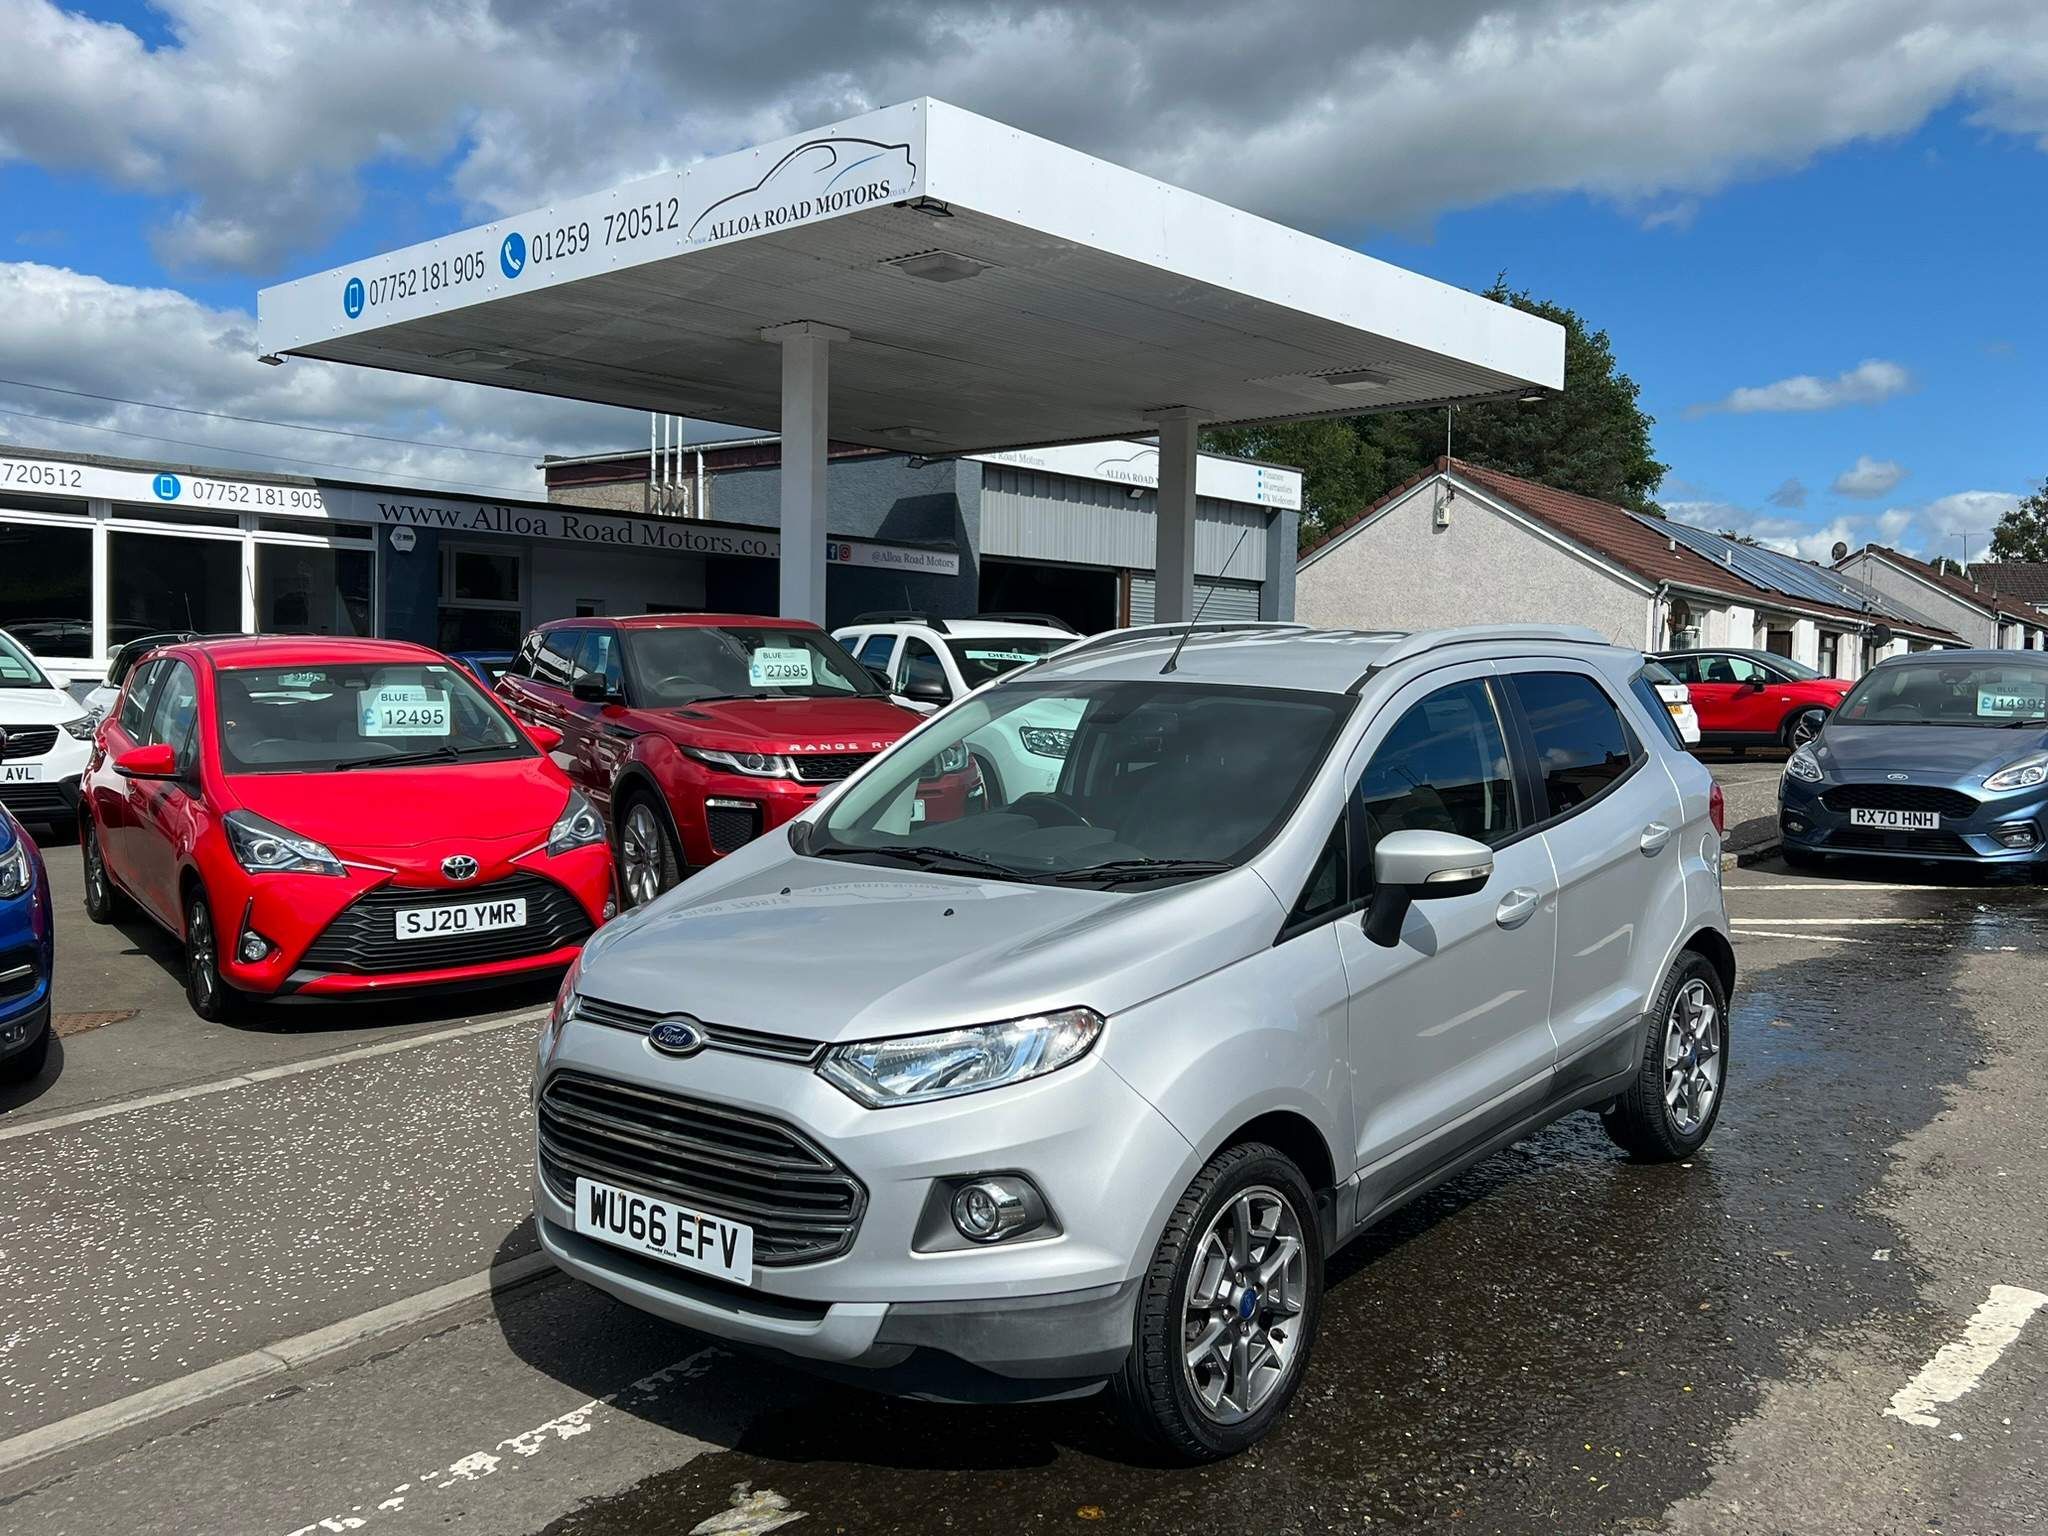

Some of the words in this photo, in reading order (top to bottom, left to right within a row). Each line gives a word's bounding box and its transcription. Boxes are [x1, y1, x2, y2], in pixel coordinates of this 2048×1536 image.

[708, 214, 761, 242] ALLOA
[764, 201, 812, 228] ROAD
[815, 179, 890, 215] MOTORS
[532, 222, 590, 263] 01259
[604, 197, 679, 245] 720512
[370, 269, 416, 305] 07752
[422, 261, 448, 292] 181
[454, 251, 485, 285] 905
[3, 463, 82, 487] 720512
[193, 481, 249, 503] 07752
[255, 488, 285, 506] 181
[290, 490, 323, 509] 905
[561, 516, 634, 544] Road
[641, 524, 781, 557] Motors.co.
[903, 553, 924, 566] Road
[926, 555, 954, 568] Motors
[988, 652, 1025, 660] DIESEL
[766, 664, 808, 677] 27995
[381, 693, 409, 702] BLUE
[385, 709, 444, 725] 12495
[788, 743, 859, 751] RANGE
[5, 767, 35, 781] AVL
[1856, 809, 1898, 824] RX70
[1902, 812, 1934, 827] HNH
[406, 908, 467, 933] SJ20
[474, 903, 516, 926] YMR
[658, 1026, 687, 1044] Ford
[591, 1185, 667, 1247] WU66
[676, 1211, 738, 1269] EFV
